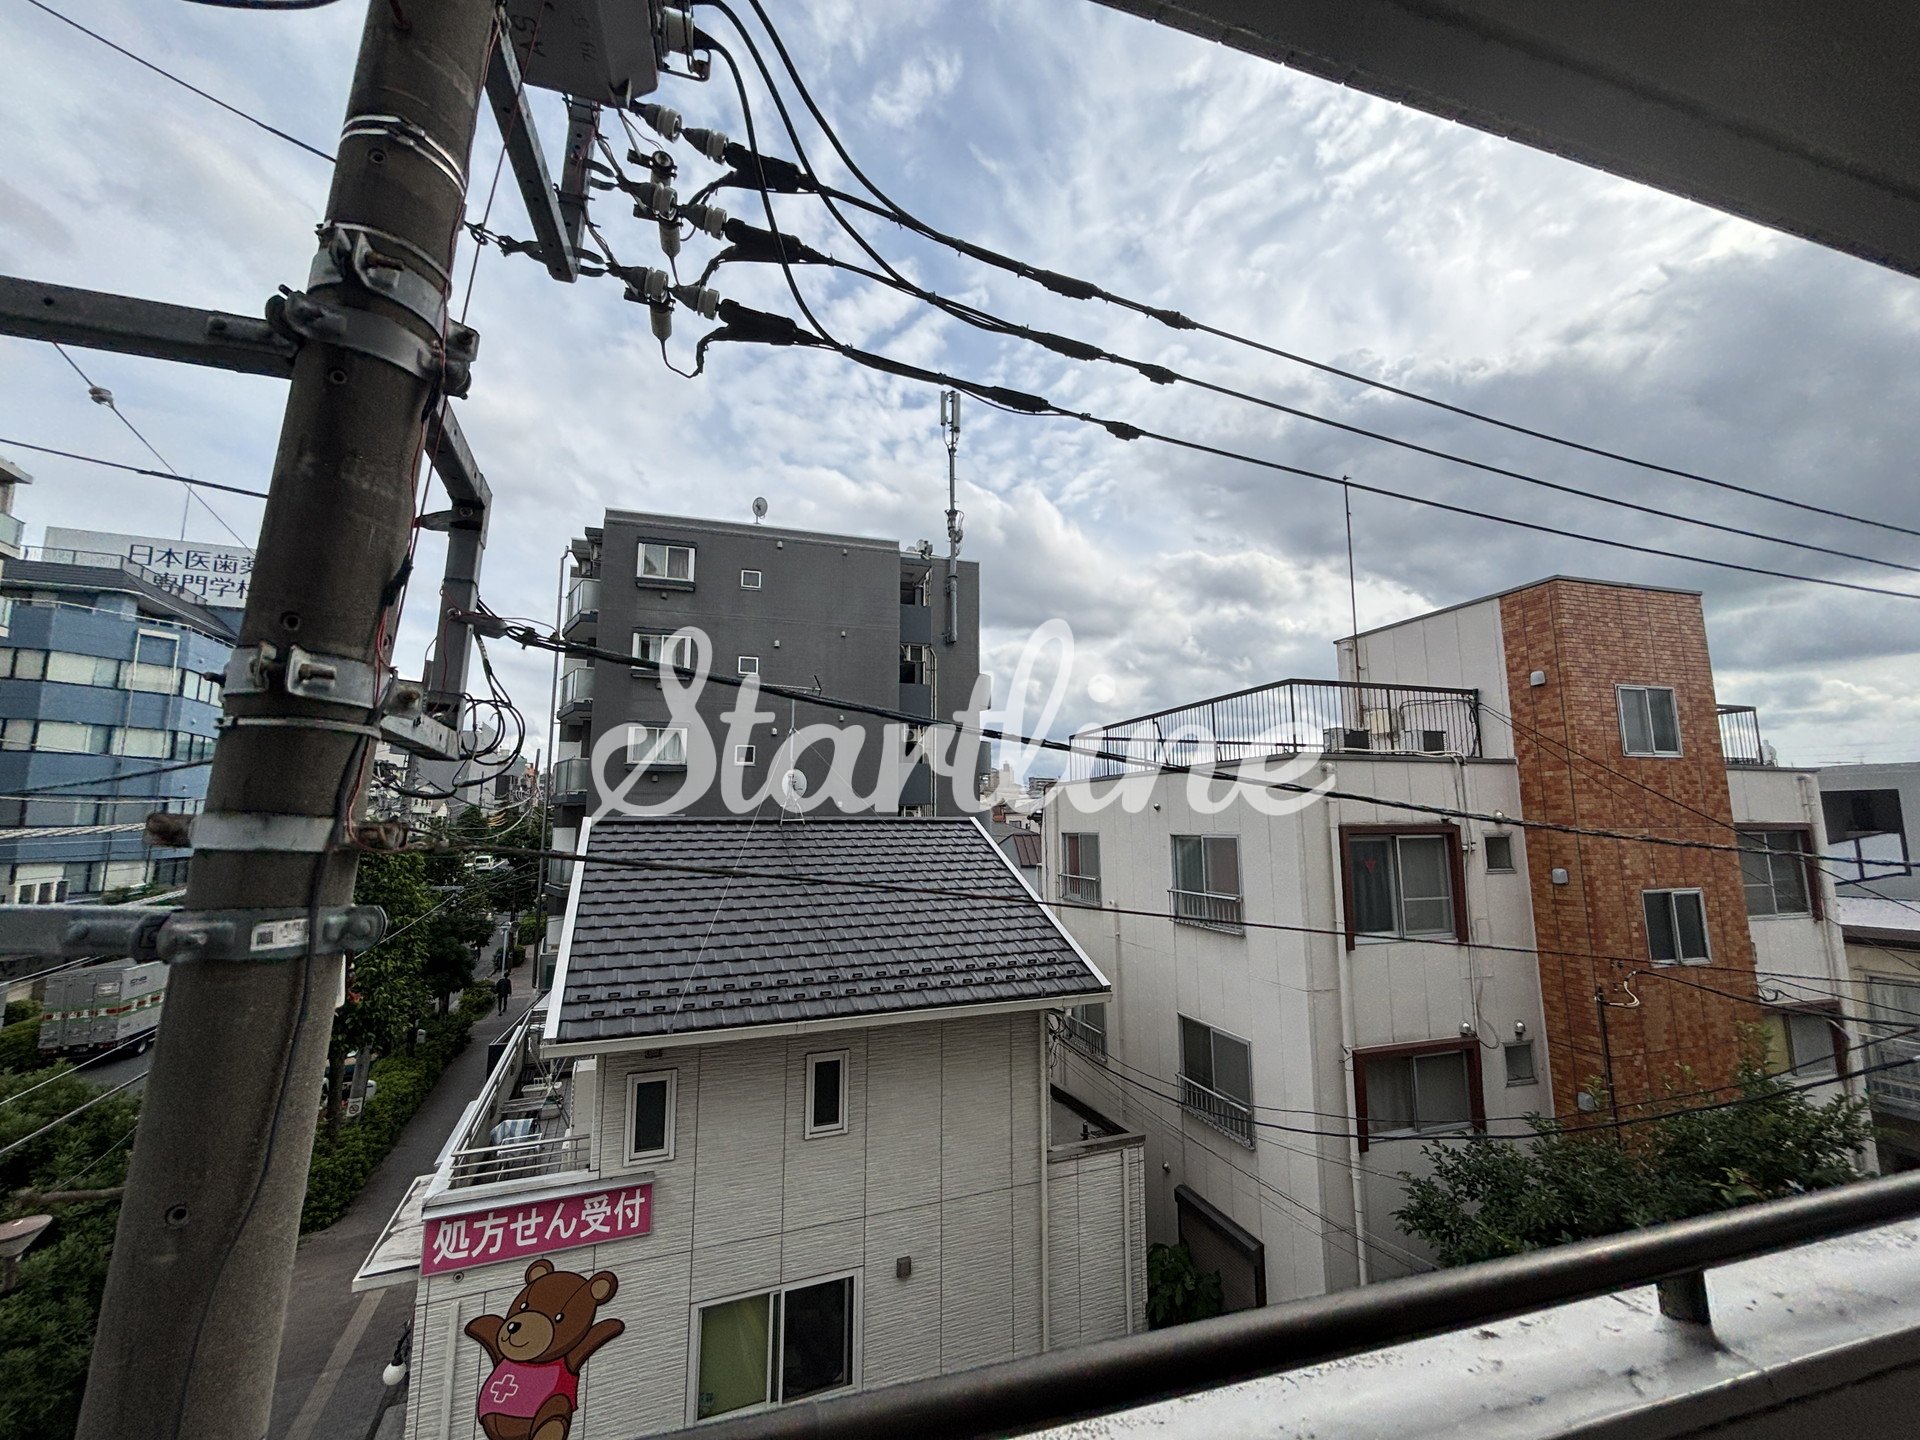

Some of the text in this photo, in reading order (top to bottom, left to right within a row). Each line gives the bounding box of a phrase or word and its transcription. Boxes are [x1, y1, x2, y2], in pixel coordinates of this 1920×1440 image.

[433, 1188, 646, 1265] 処方せん受付
